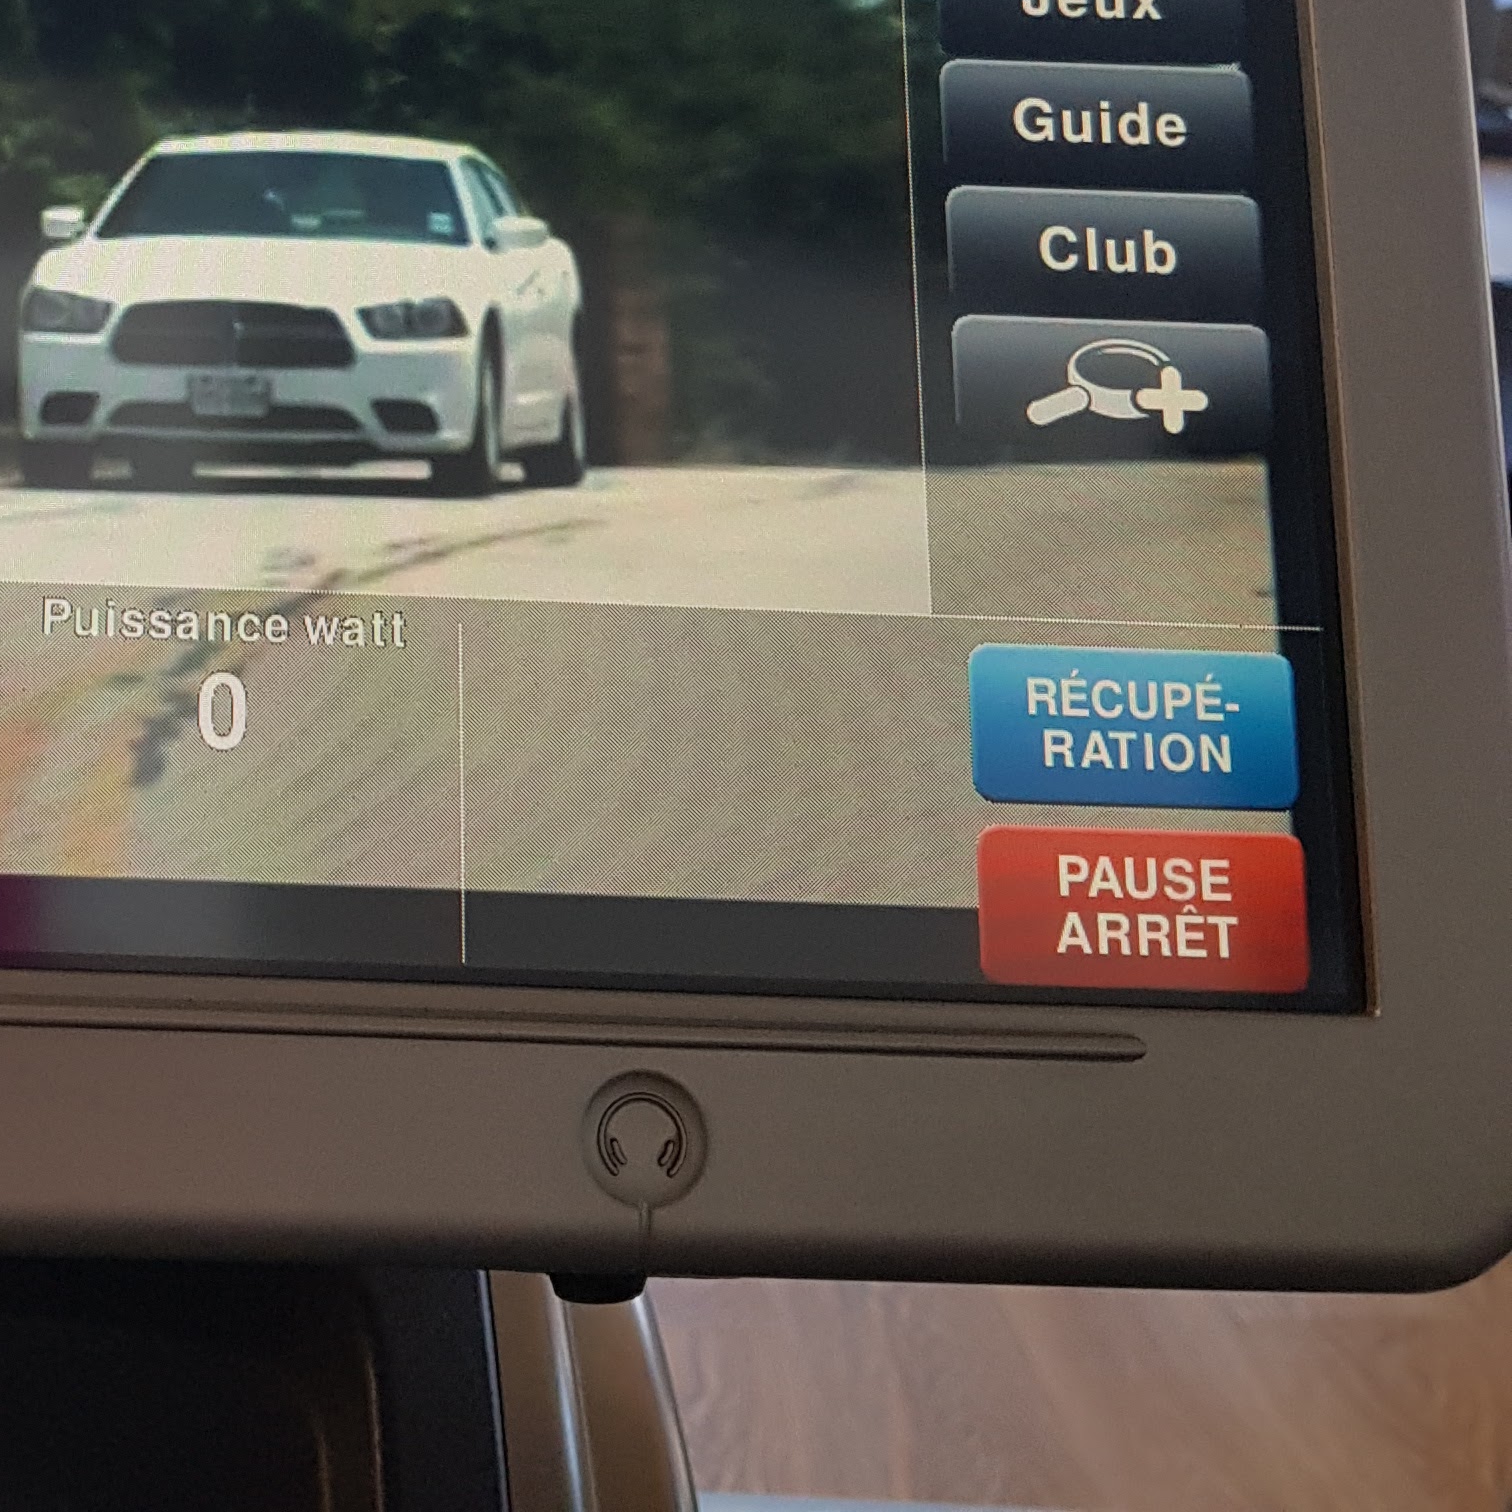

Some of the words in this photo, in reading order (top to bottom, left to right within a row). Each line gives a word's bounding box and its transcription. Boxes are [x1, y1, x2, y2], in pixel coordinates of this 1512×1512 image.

[1012, 96, 1188, 148] Guide
[1038, 224, 1178, 276] Club
[42, 596, 289, 644] Puissance
[303, 610, 408, 649] watt
[197, 670, 248, 752] 0
[1025, 668, 1241, 722] RÉCUPÉ-
[1041, 728, 1233, 774] RATION
[1057, 853, 1233, 903] PAUSE
[1056, 904, 1239, 960] ARRÊT
